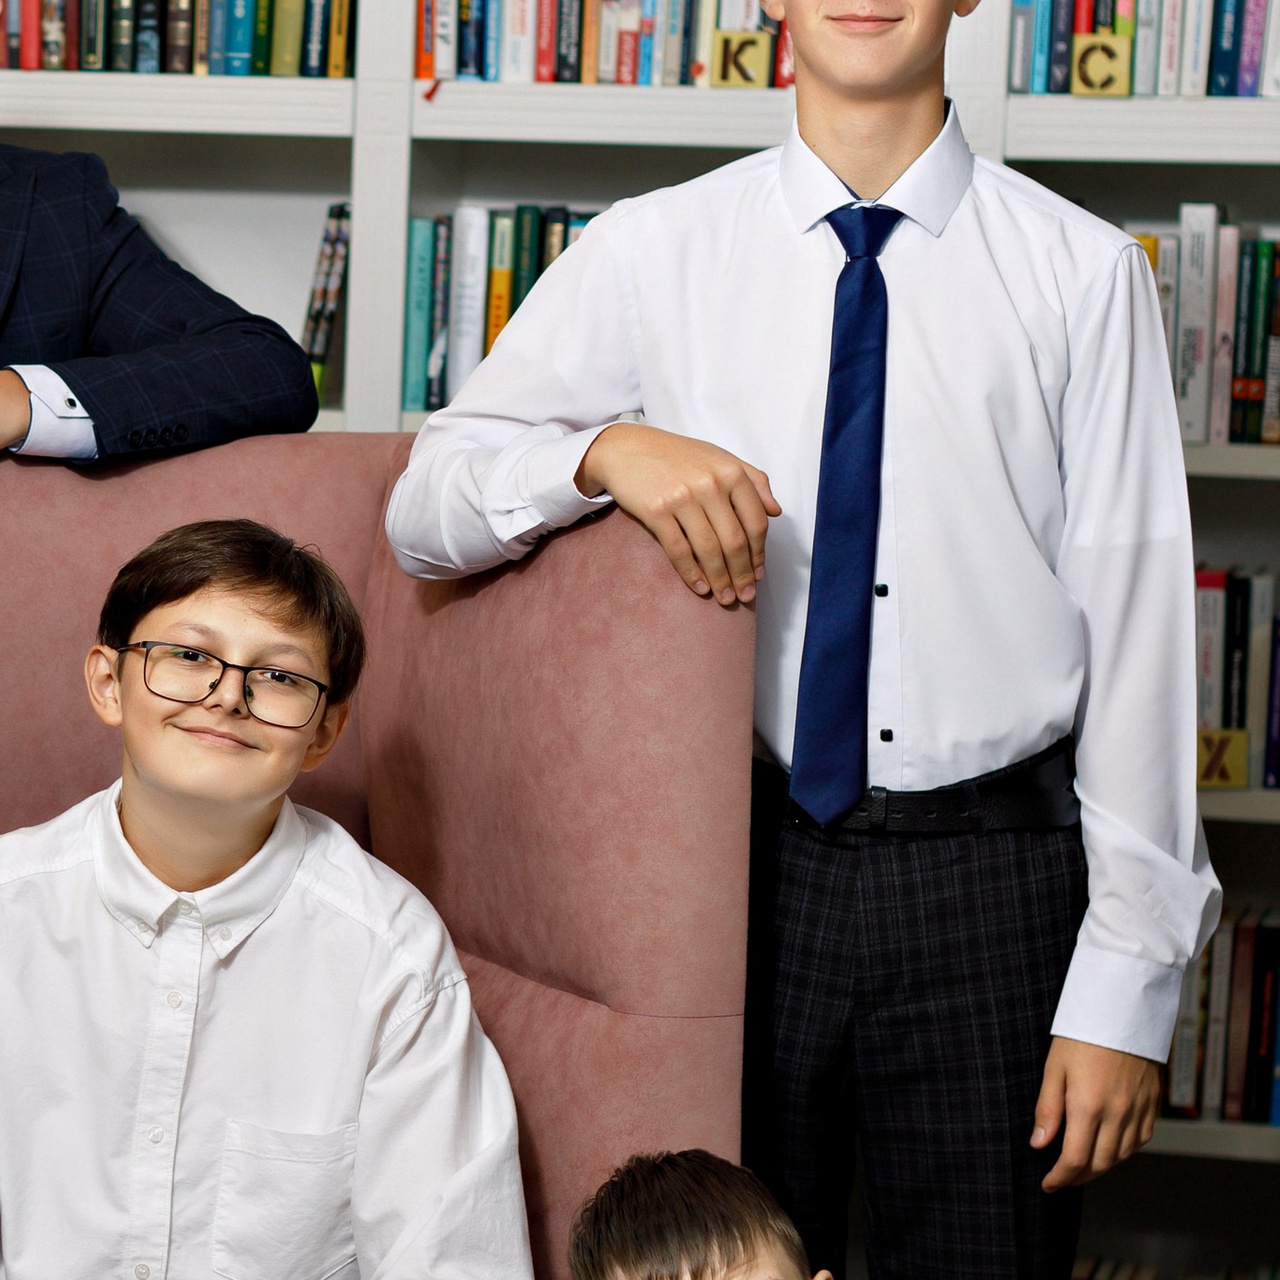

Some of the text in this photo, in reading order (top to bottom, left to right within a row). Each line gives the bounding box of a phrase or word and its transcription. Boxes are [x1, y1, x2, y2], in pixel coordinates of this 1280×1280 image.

[721, 38, 757, 82] К
[1078, 45, 1116, 89] С
[1201, 735, 1231, 781] Х
